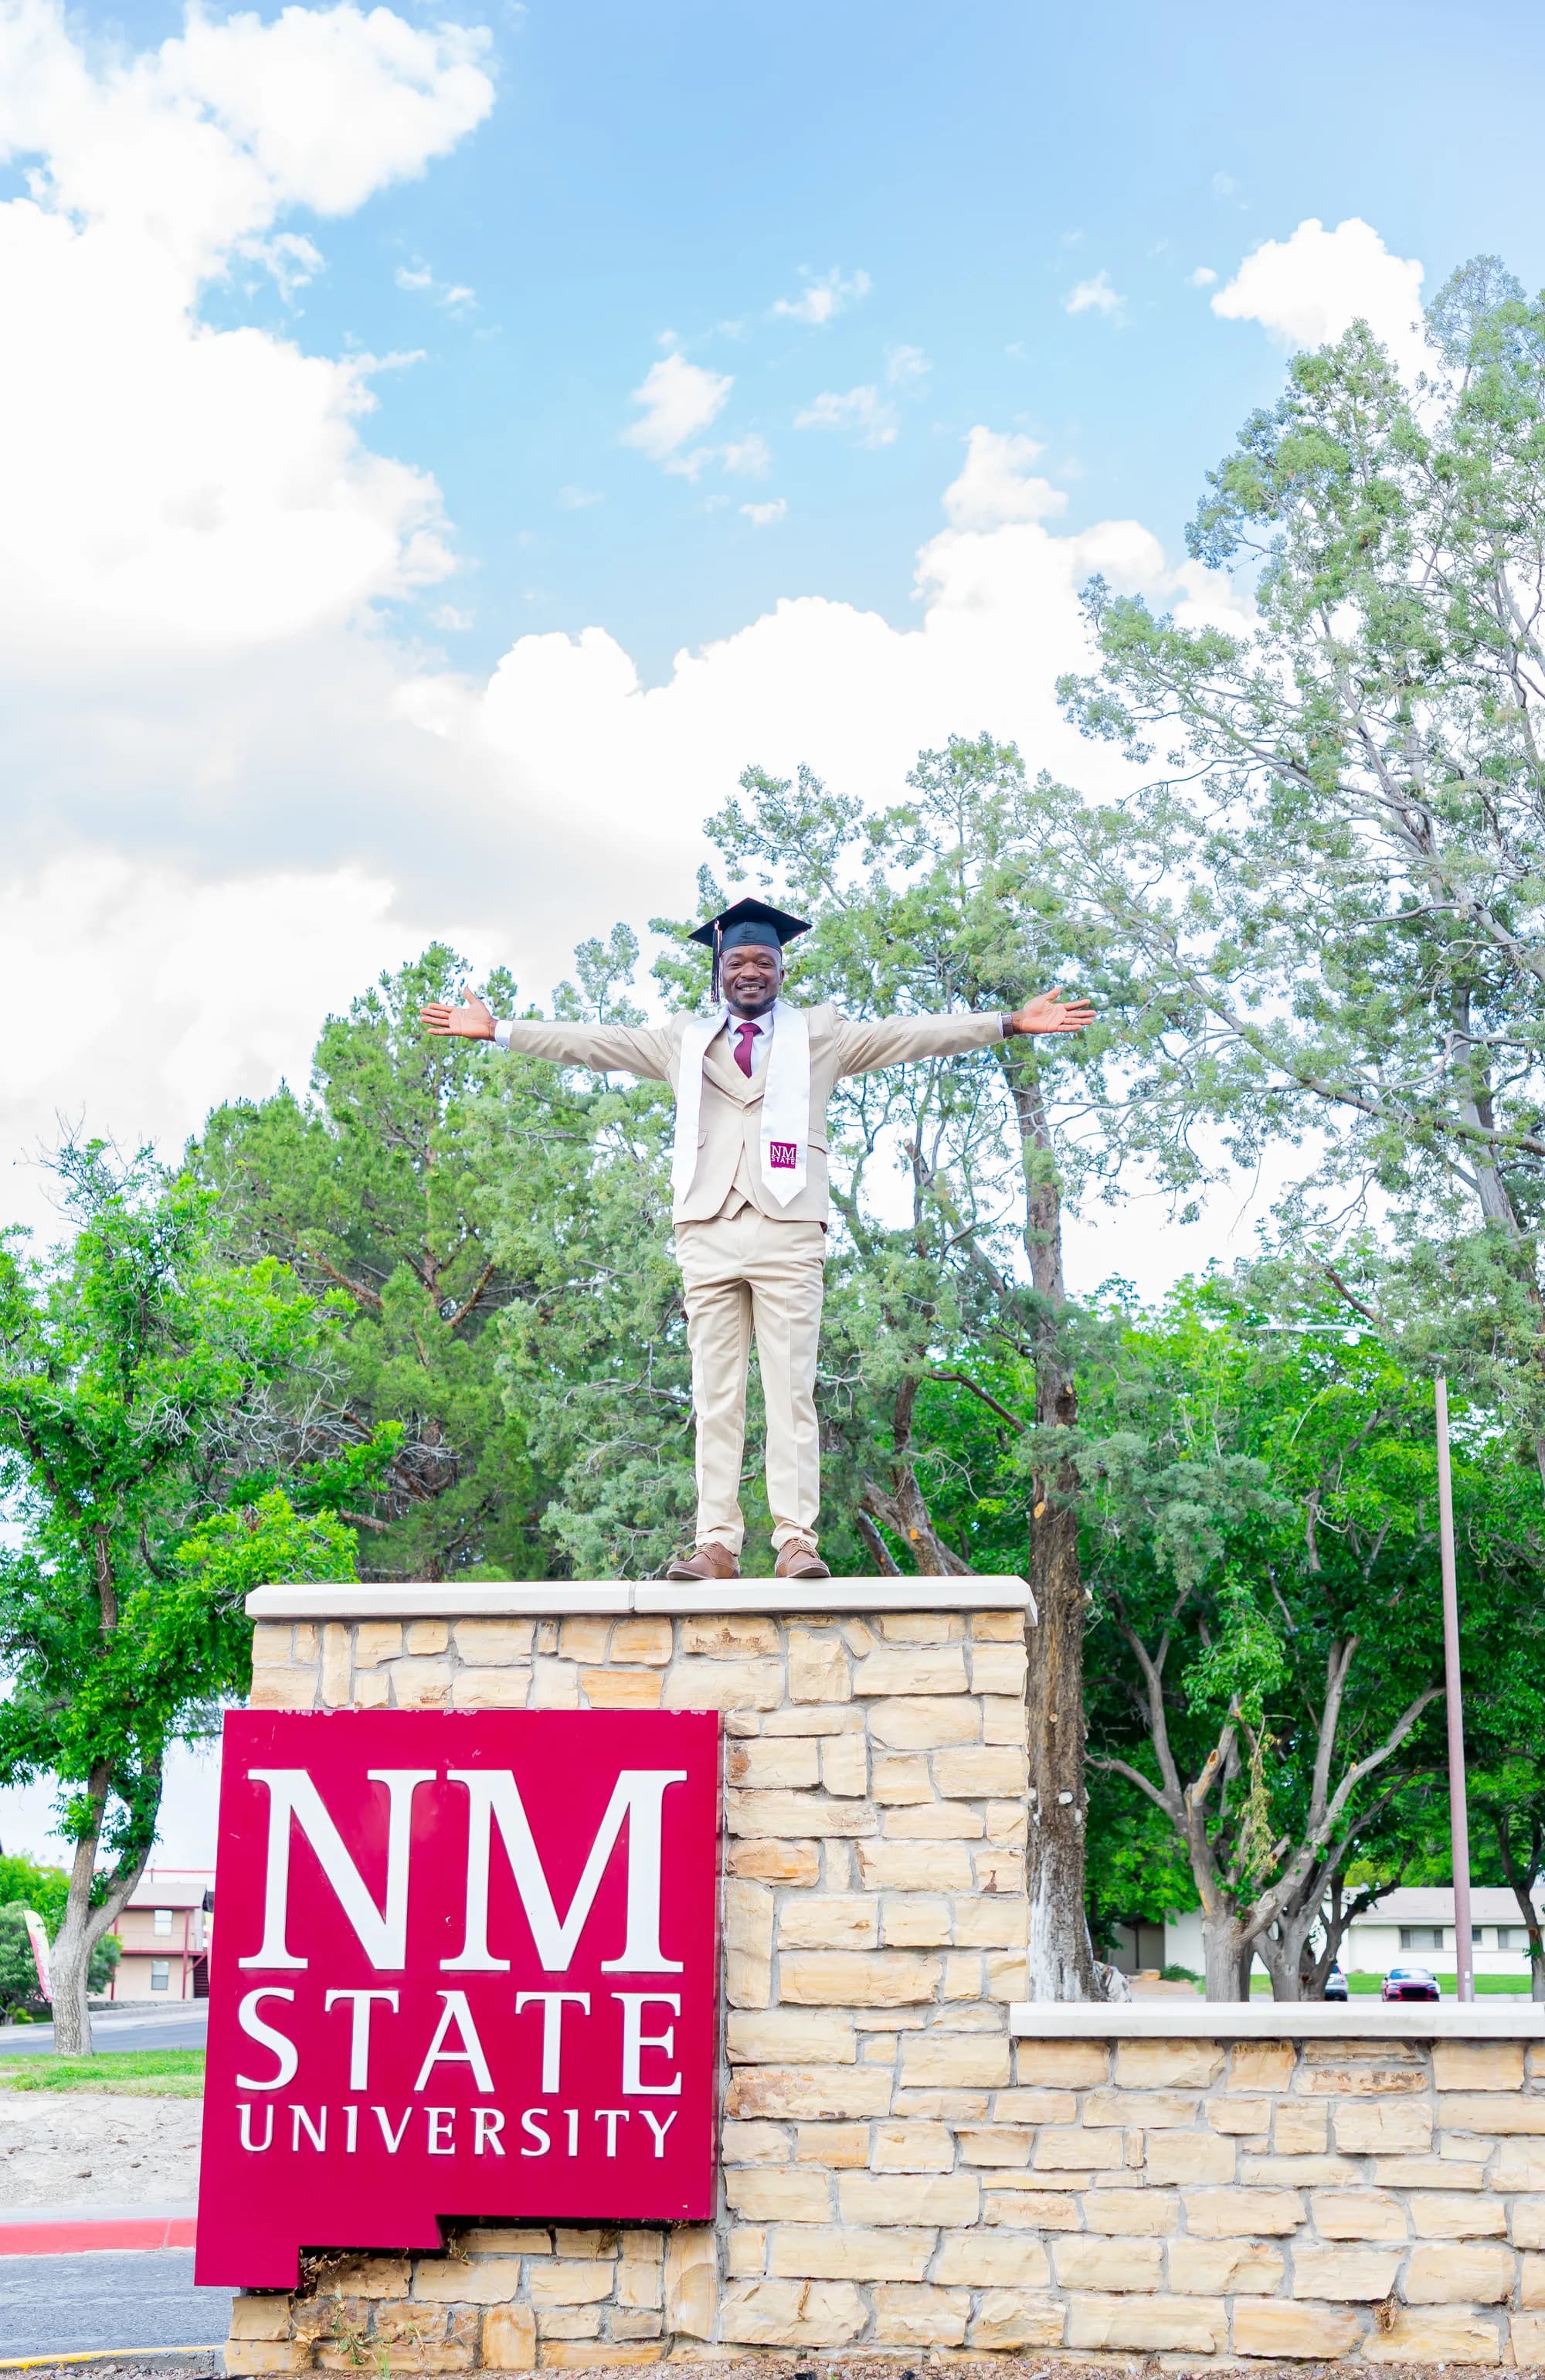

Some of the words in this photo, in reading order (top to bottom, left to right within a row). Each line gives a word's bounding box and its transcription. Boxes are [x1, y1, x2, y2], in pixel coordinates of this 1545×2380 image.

[771, 1144, 796, 1158] NM
[771, 1155, 795, 1164] STATE
[239, 1770, 687, 1972] NM
[236, 1987, 682, 2095] STATE
[236, 2104, 678, 2157] UNIVERSITY
